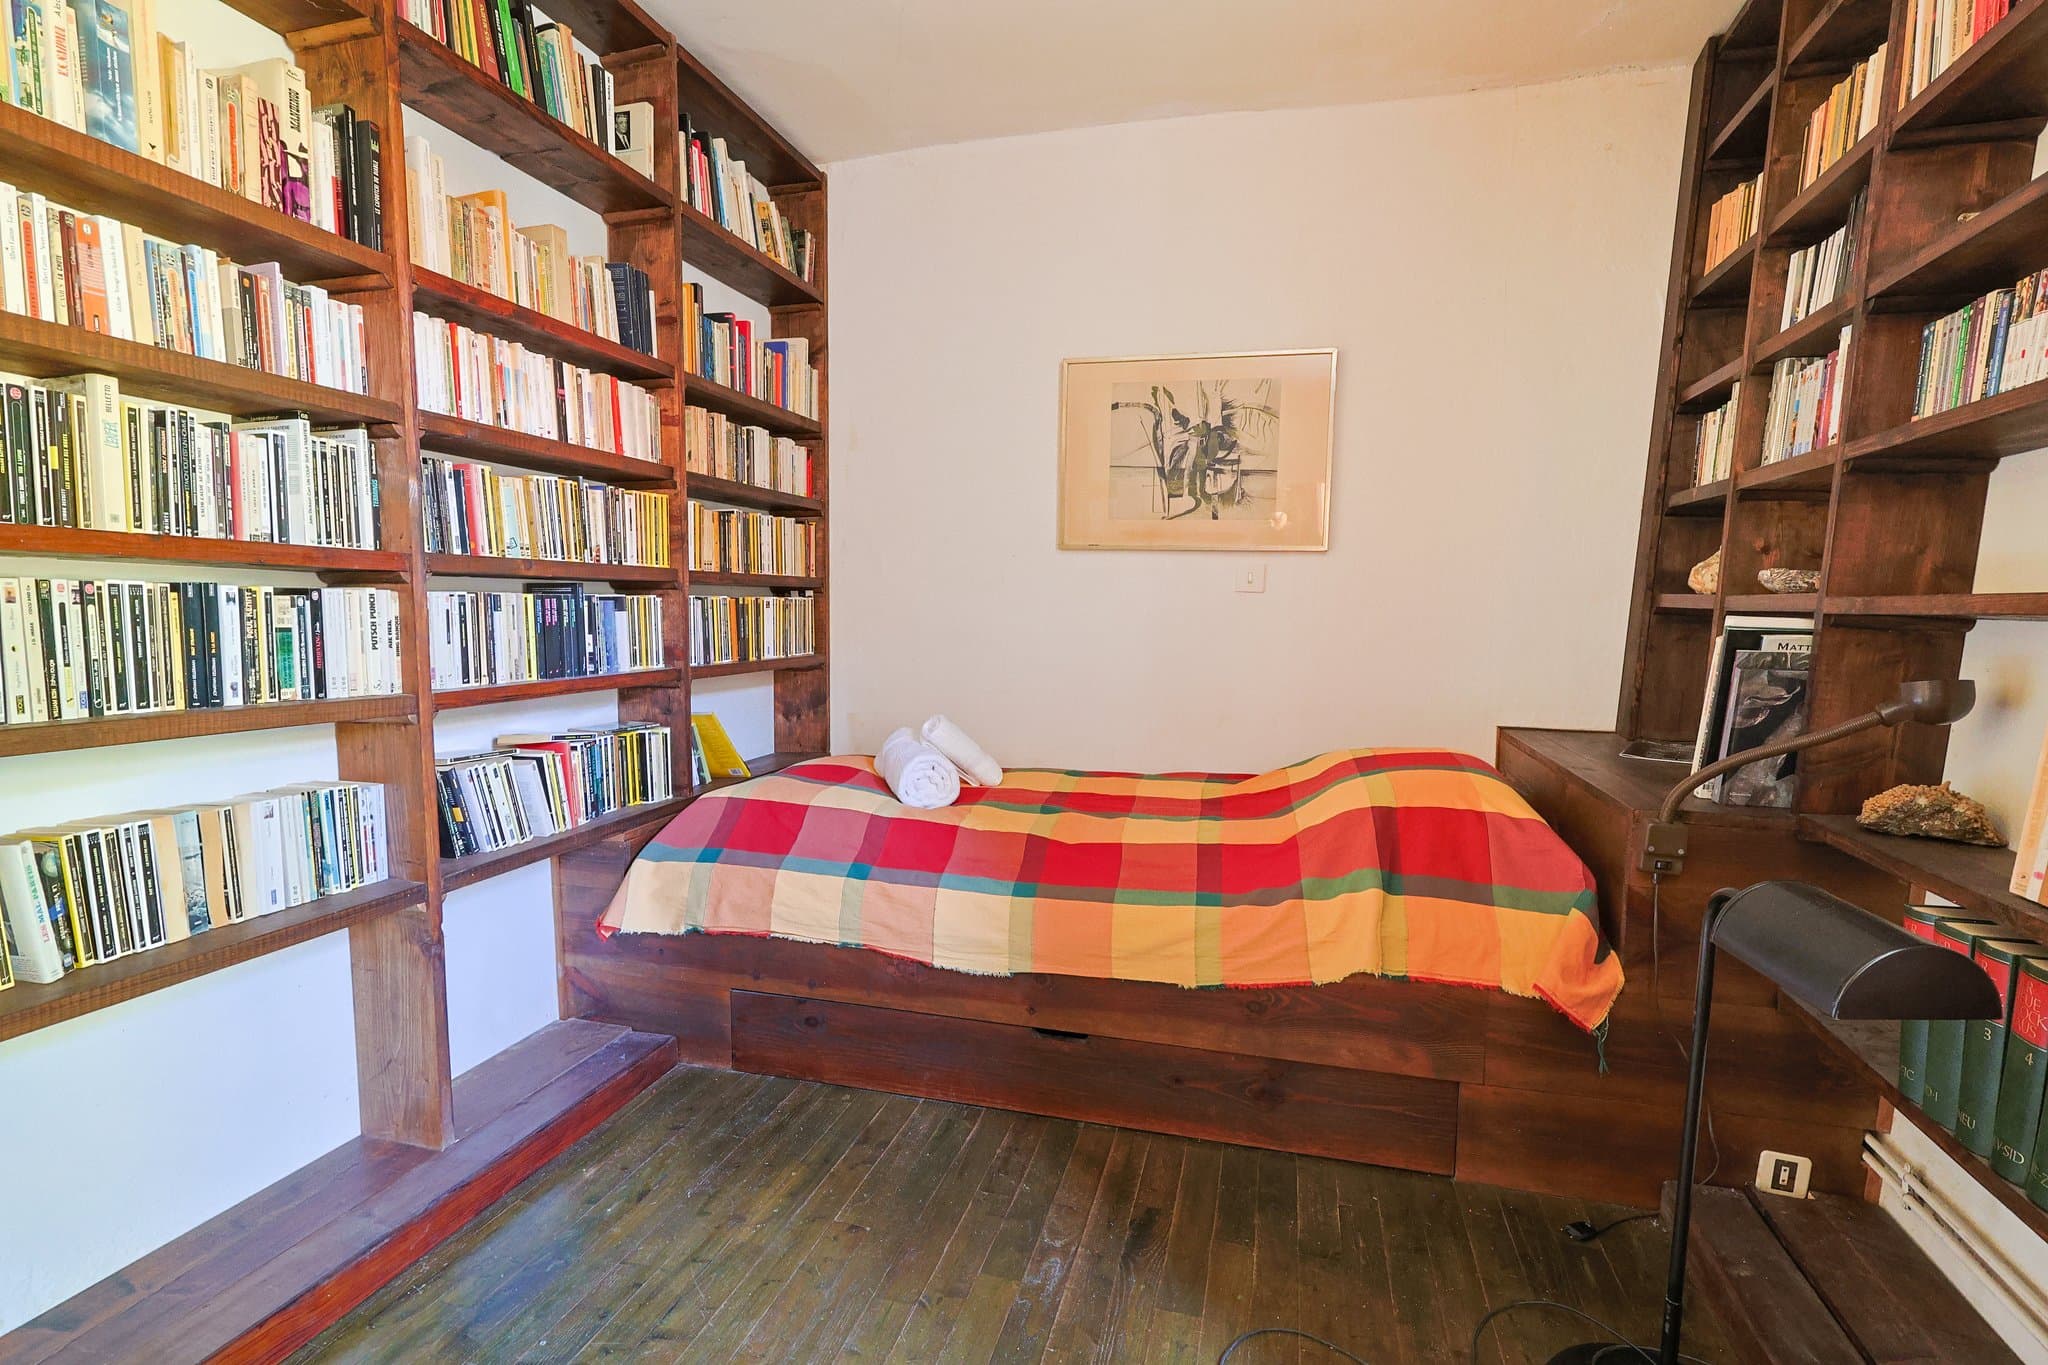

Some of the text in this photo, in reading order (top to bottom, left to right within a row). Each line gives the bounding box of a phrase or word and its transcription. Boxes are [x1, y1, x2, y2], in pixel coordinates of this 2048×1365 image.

[288, 88, 301, 132] MANDINGO
[104, 385, 112, 413] BELLETTO
[246, 620, 254, 639] PAUL
[370, 621, 378, 650] PUTSCH
[1777, 642, 1812, 652] MATT
[25, 864, 50, 943] LES MAL PARTIS
[1983, 1027, 1992, 1041] 3
[2024, 1052, 2034, 1066] 4
